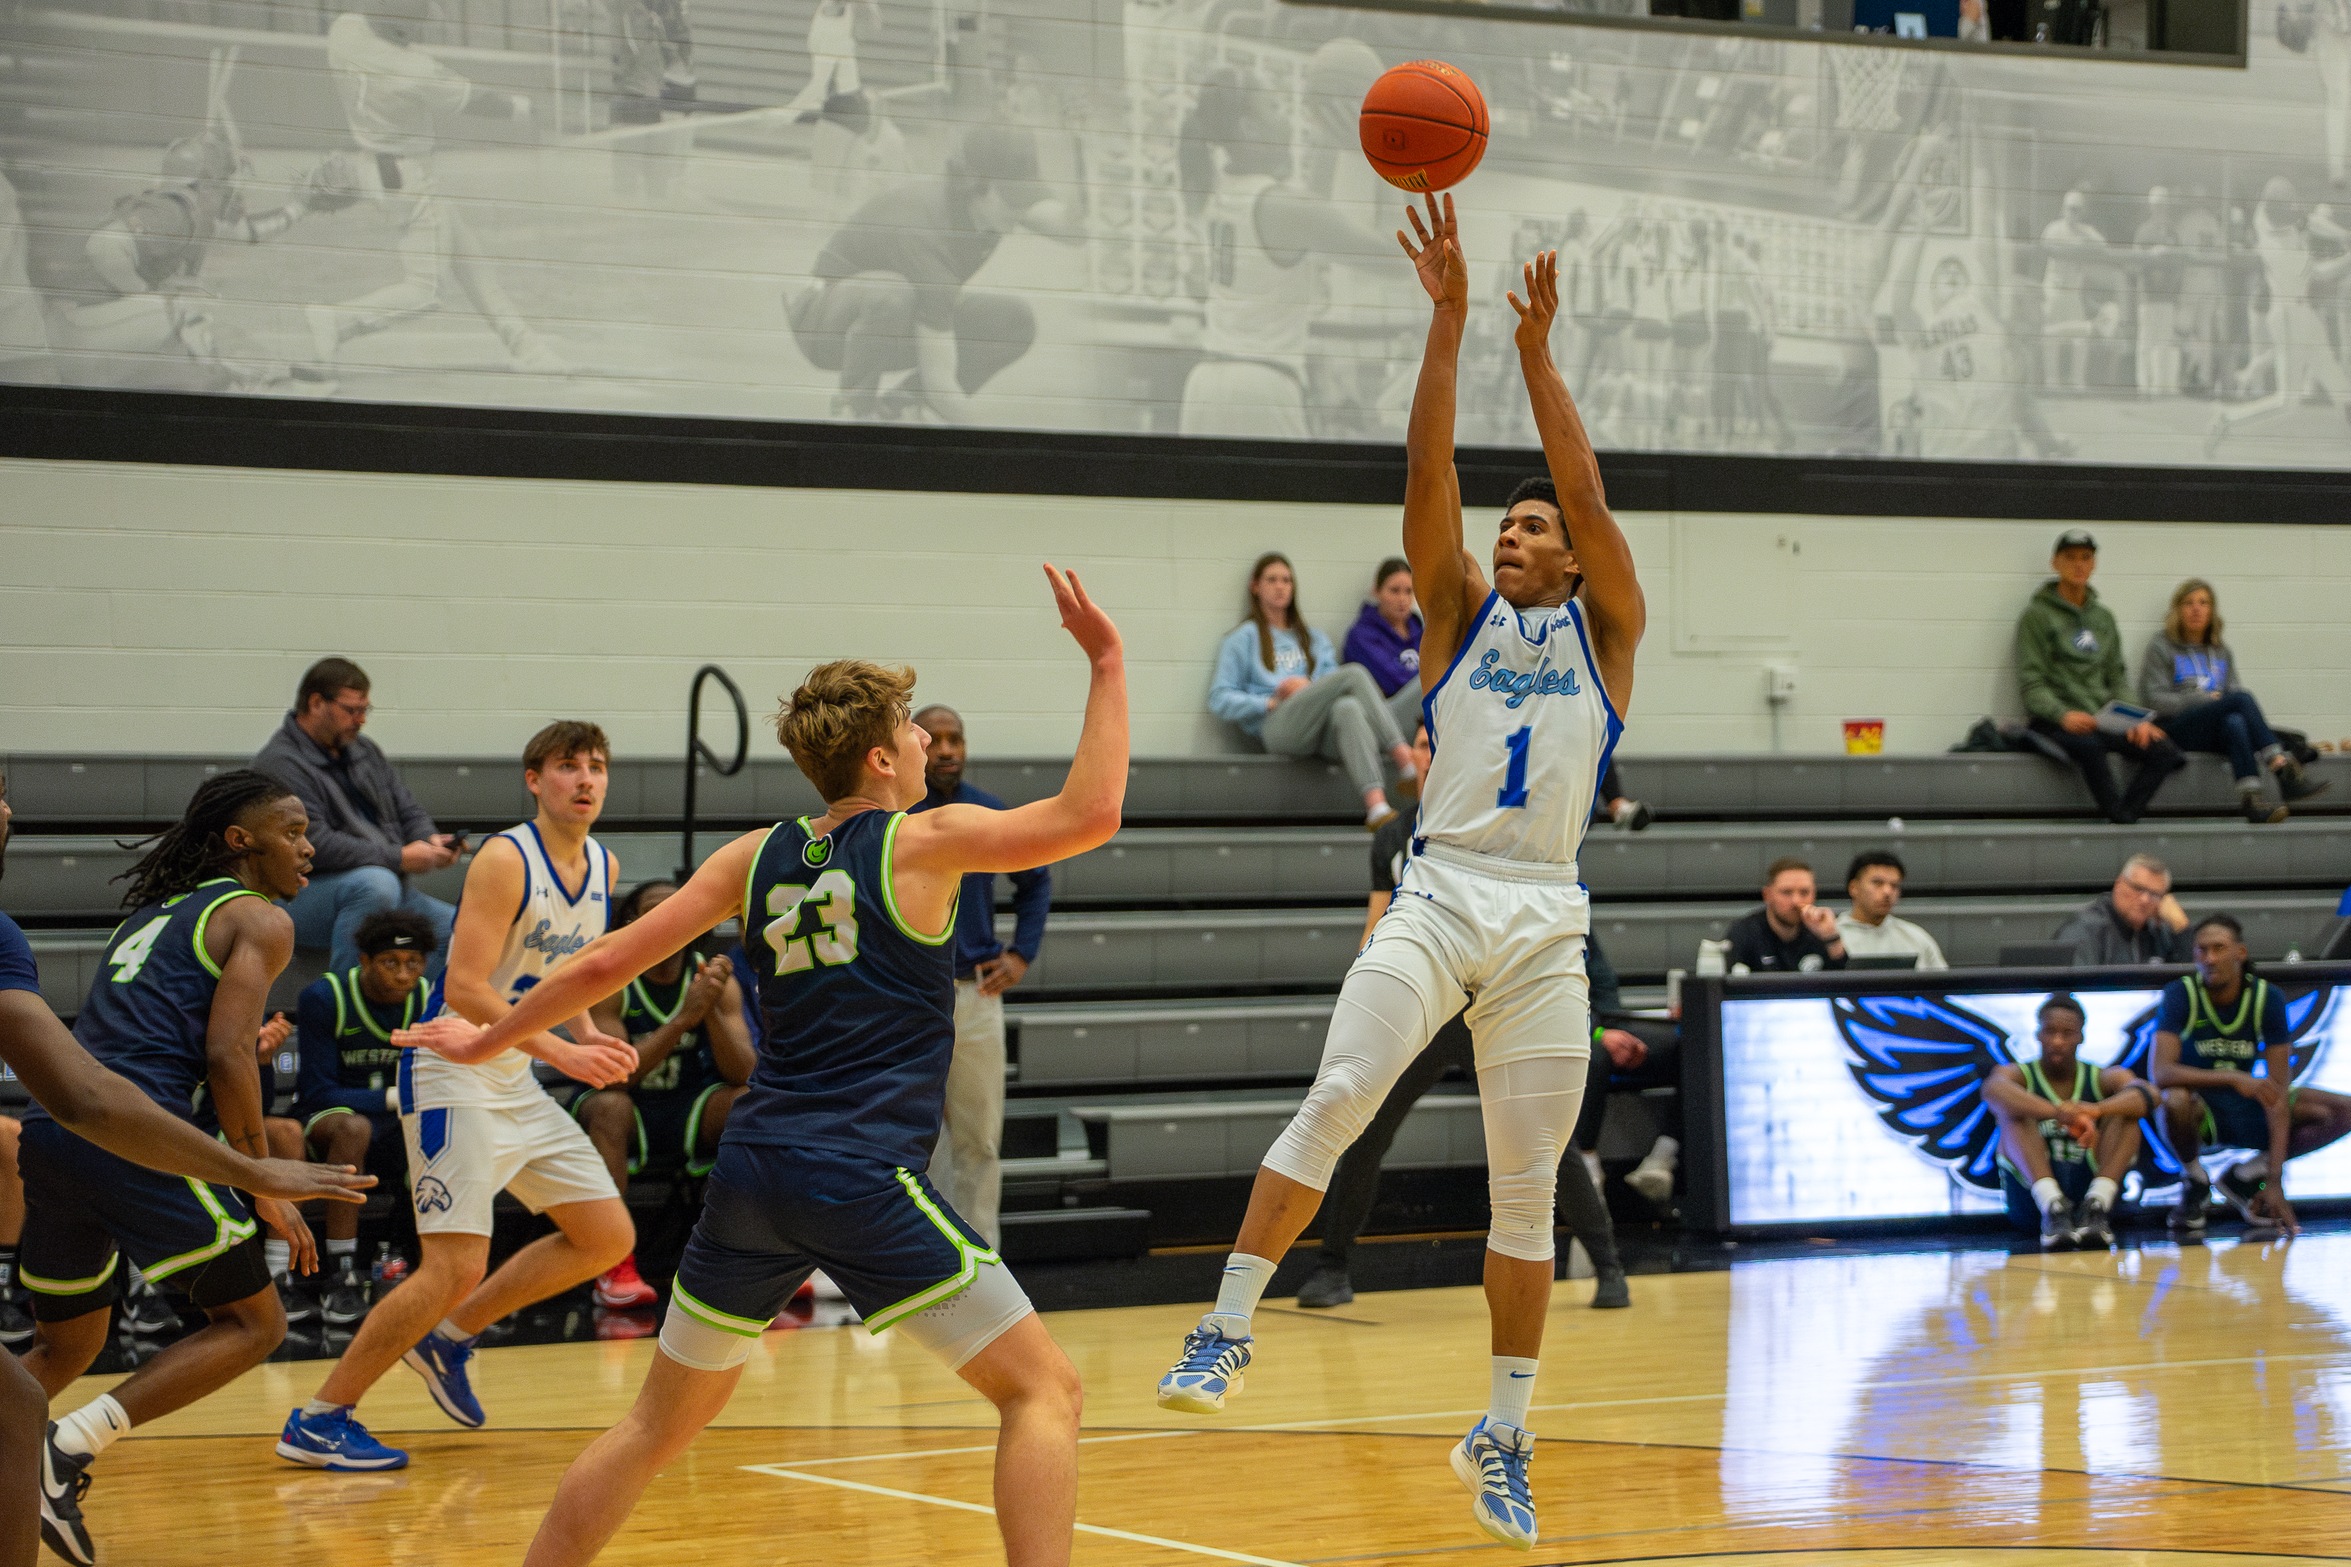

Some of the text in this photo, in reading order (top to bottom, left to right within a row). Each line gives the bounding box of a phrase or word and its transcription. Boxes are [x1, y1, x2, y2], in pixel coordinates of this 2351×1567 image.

[1941, 342, 1975, 382] 43
[1469, 648, 1581, 709] Eagles
[1496, 725, 1533, 809] 1
[108, 914, 173, 984] 4
[524, 918, 595, 965] Eagle
[762, 868, 860, 977] 23
